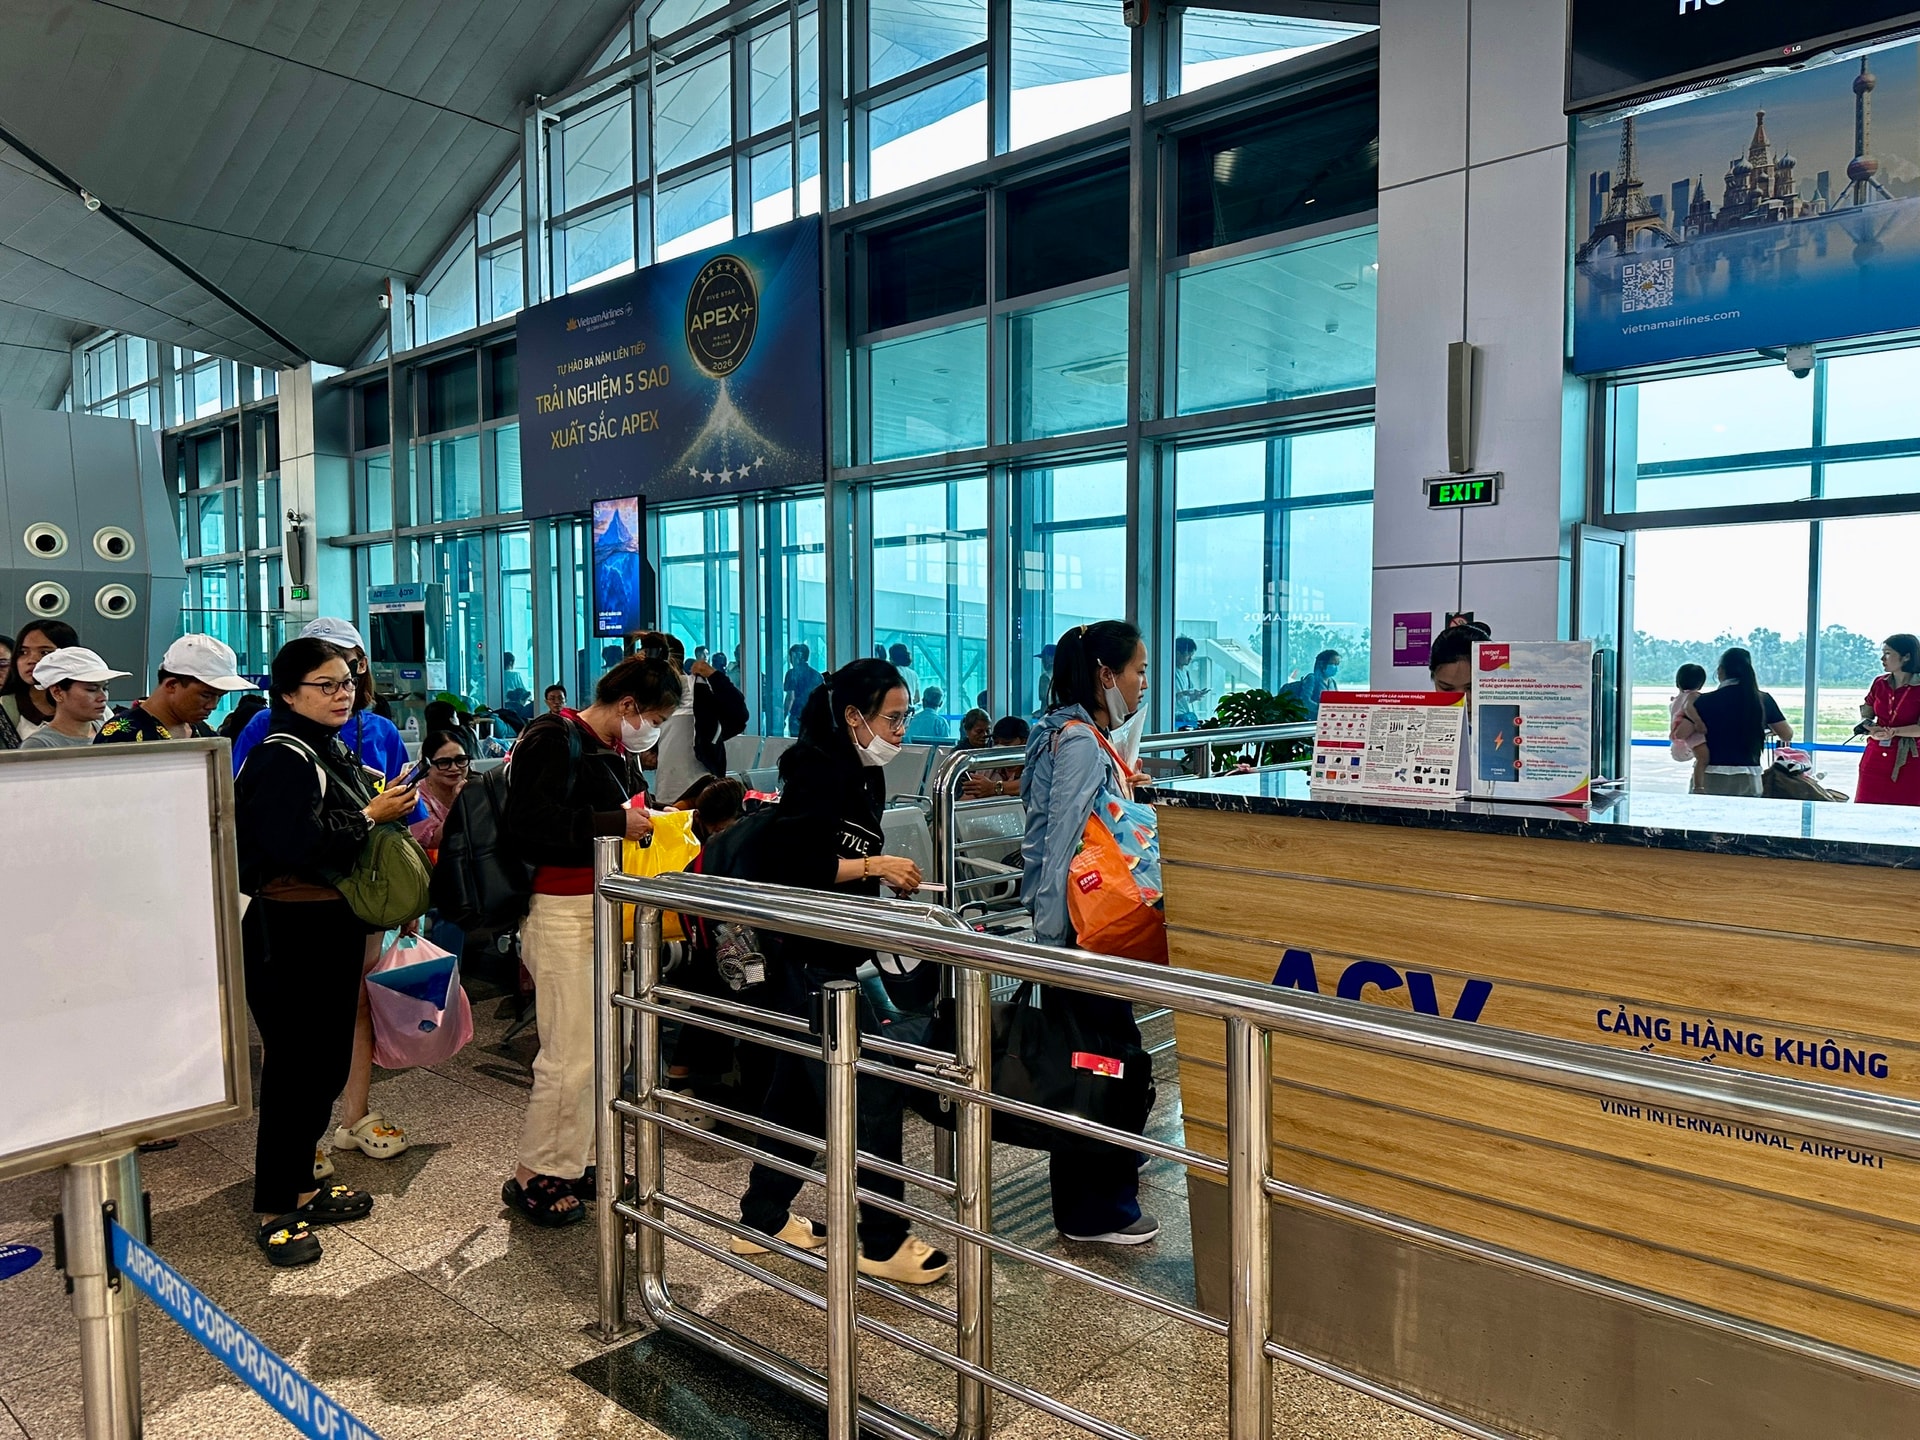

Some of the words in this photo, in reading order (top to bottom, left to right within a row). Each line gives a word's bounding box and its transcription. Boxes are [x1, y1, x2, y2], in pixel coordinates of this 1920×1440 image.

[707, 293, 720, 301] FIVE
[720, 288, 736, 298] STAR
[690, 303, 740, 333] APEX
[1622, 310, 1740, 335] vietnamairlines.com
[568, 358, 584, 373] HÀO
[584, 357, 594, 368] BA
[595, 351, 612, 366] NĂM
[630, 340, 647, 356] TIẾP
[712, 340, 732, 348] AIRLINE
[712, 358, 733, 370] 2026
[536, 384, 564, 414] TRẢI
[567, 373, 621, 408] NGHIỆM
[625, 373, 634, 394] 5
[638, 364, 670, 392] SAO
[551, 418, 586, 450] XUẤT
[588, 409, 618, 442] SẮC
[621, 408, 660, 437] APEX
[1438, 482, 1485, 503] EXIT
[837, 830, 870, 854] TYLE
[1080, 872, 1097, 886] REWE
[1597, 1004, 1671, 1042] CẢNG
[1681, 1018, 1764, 1058] HÀNG
[1774, 1038, 1888, 1079] KHÔNG
[1600, 1099, 1641, 1120] VINH
[1647, 1108, 1794, 1150] INTERNATIONAL
[126, 1240, 192, 1320] AIRPORTS
[194, 1296, 310, 1422] CORPORATION
[313, 1395, 340, 1440] OF
